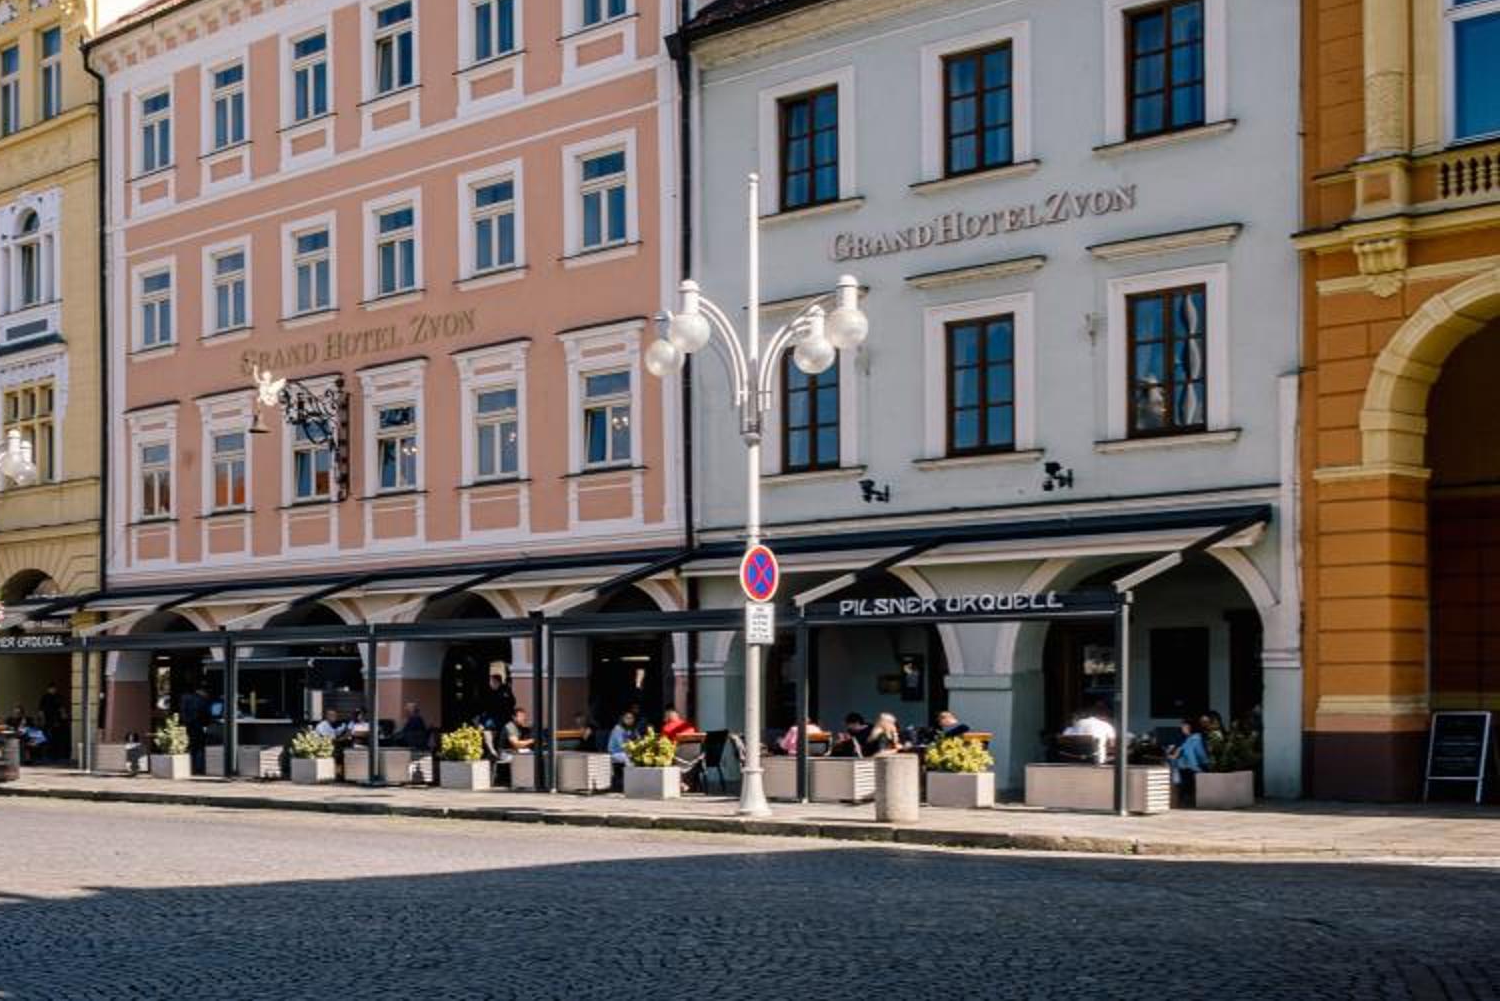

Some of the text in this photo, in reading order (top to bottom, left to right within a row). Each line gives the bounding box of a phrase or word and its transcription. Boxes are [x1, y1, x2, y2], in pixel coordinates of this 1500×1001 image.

[833, 184, 1138, 262] GRAND HOTEL ZVON
[241, 309, 476, 375] GRAND HOTEL ZVON
[839, 591, 1064, 617] PILSNER URQUELL
